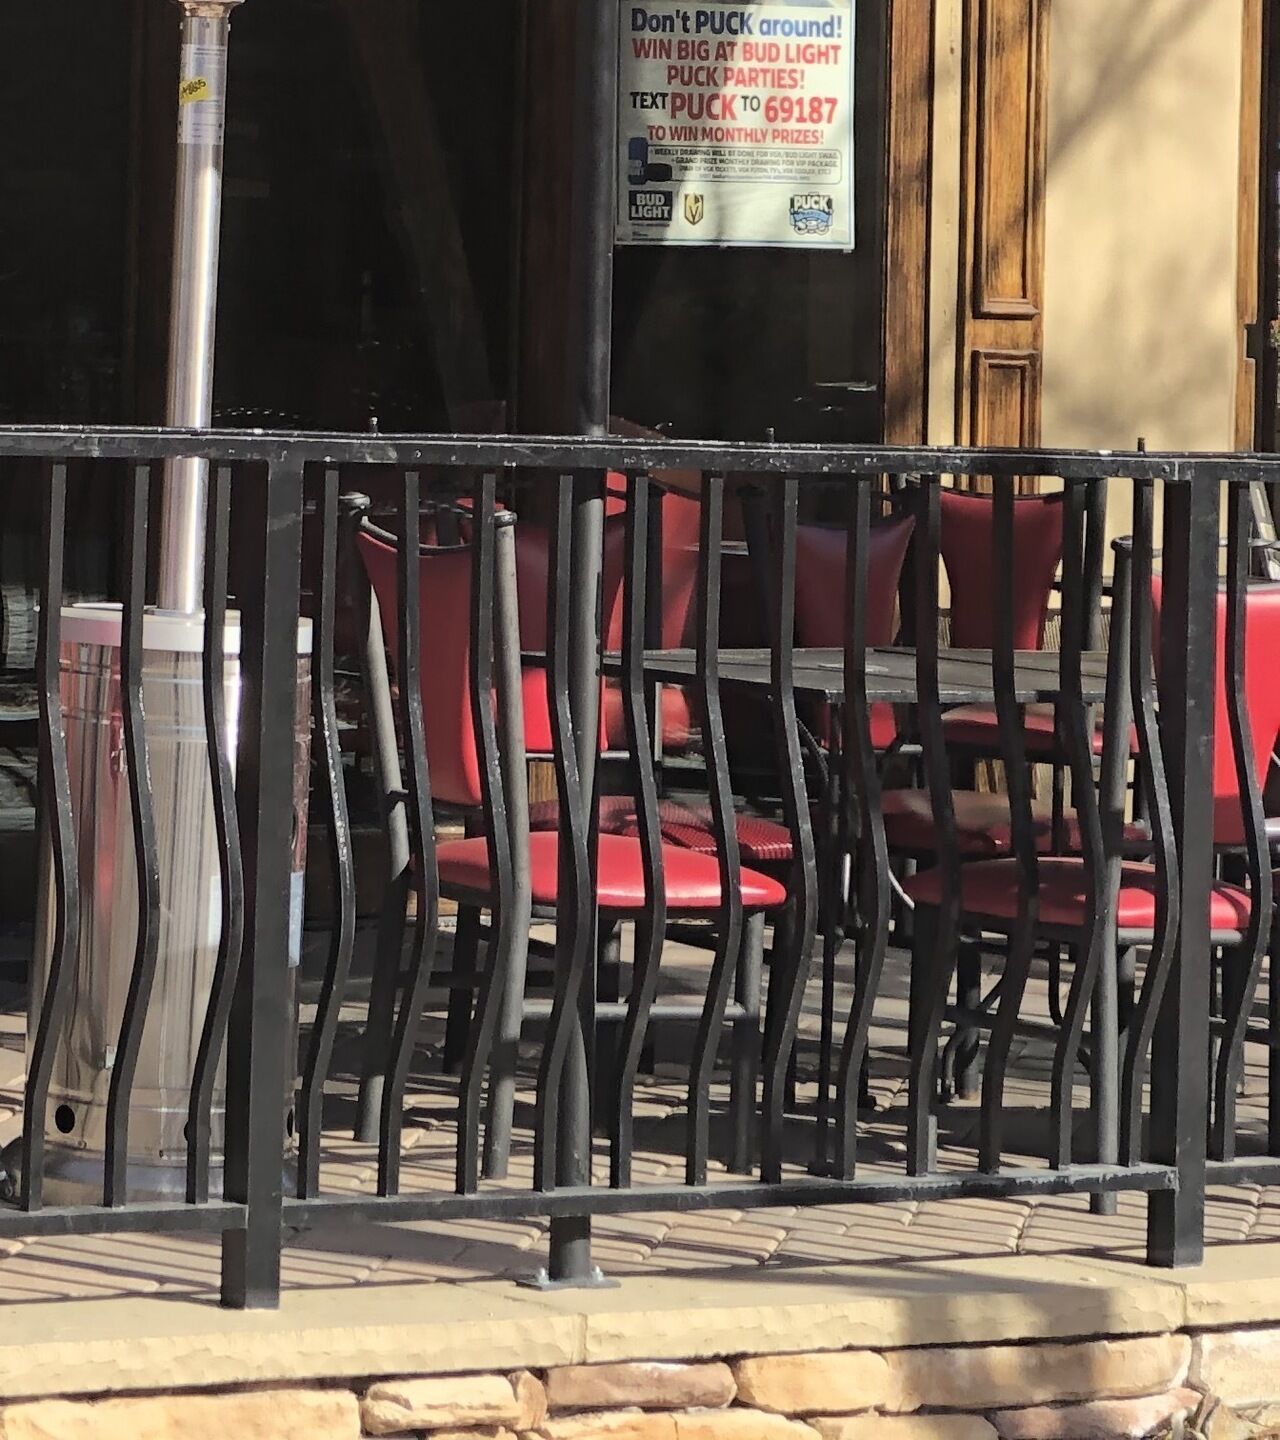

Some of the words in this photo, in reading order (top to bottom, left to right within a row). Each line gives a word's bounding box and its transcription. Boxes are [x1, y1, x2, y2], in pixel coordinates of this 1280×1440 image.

[631, 7, 691, 34] Don't
[695, 10, 754, 36] PUCK
[759, 15, 842, 38] around!
[631, 38, 672, 60] WIN
[677, 39, 710, 61] BIG
[714, 41, 738, 61] AT
[742, 41, 781, 63] BUD
[785, 43, 842, 65] LIGHT
[666, 65, 719, 88] PUCK
[723, 66, 806, 90] PARTIES!
[630, 91, 669, 109] TEXT
[670, 92, 738, 120] PUCK
[741, 95, 761, 111] TO
[764, 96, 838, 124] 69187
[647, 125, 666, 141] TO
[669, 126, 698, 142] WIN
[701, 127, 768, 144] MONTHLY
[771, 129, 824, 145] PRIZES!
[636, 193, 665, 206] BUD
[793, 195, 829, 212] PUCK
[631, 206, 671, 219] LIGHT
